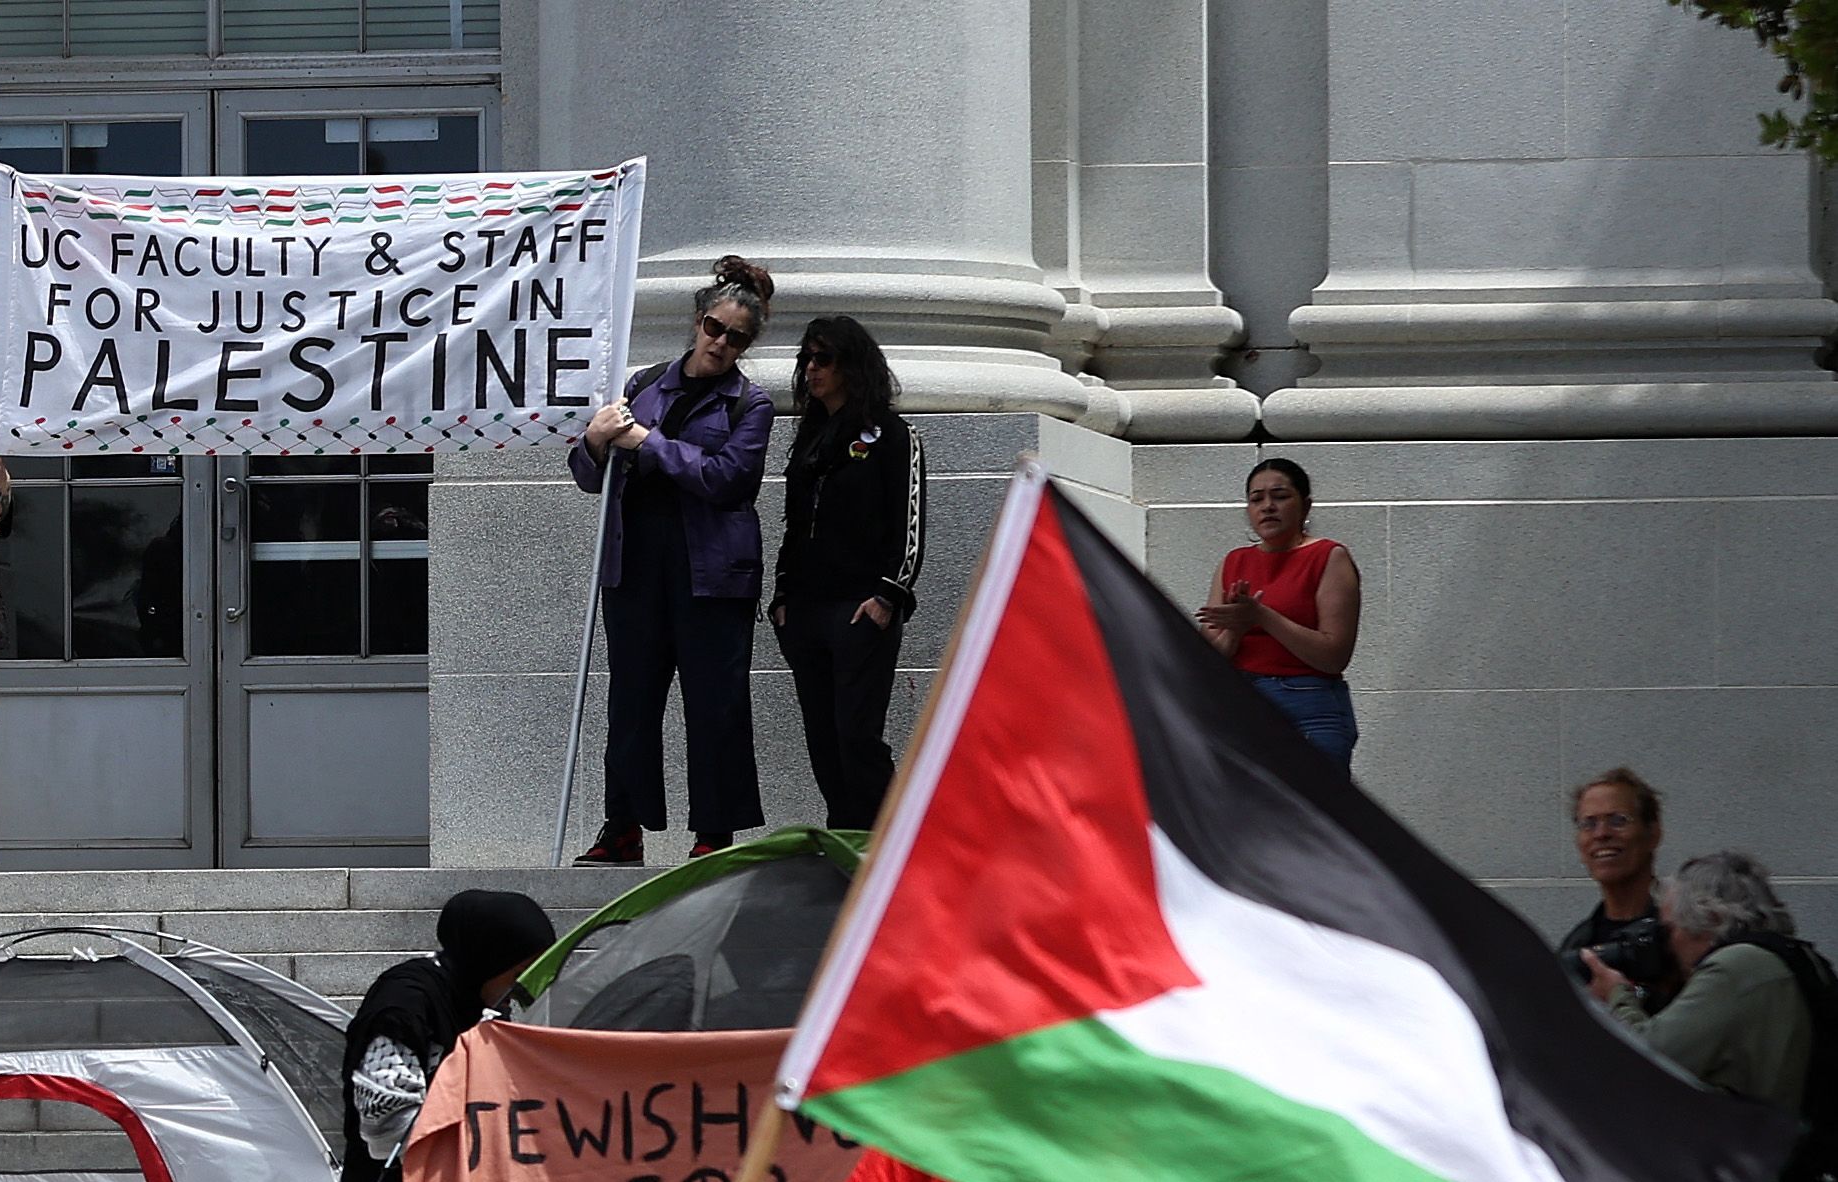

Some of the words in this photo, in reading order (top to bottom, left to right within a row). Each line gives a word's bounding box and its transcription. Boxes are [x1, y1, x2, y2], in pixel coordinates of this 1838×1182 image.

[21, 224, 82, 271] UC
[112, 233, 332, 277] FACULTY
[364, 232, 404, 276] &
[438, 219, 607, 273] STAFF
[47, 282, 162, 332] FOR
[196, 285, 479, 334] JUSTICE
[508, 277, 565, 322] IN
[19, 327, 593, 415] PALESTINE
[466, 1082, 750, 1172] JEWISH
